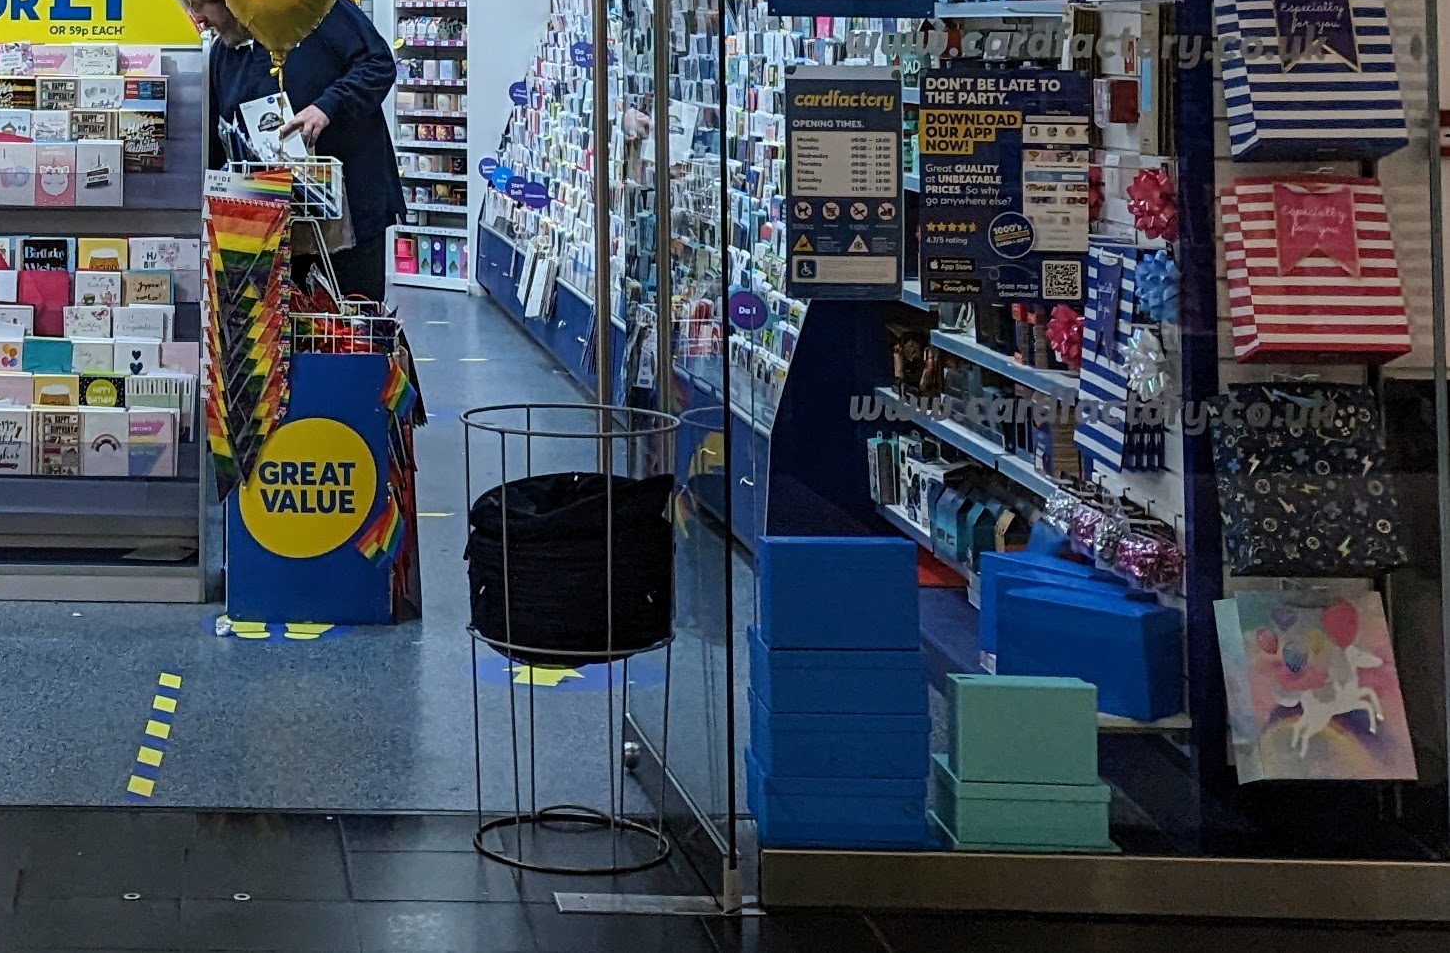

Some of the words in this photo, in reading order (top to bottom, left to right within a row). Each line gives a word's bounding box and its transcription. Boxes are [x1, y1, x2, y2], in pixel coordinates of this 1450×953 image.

[1280, 1, 1345, 18] Especially
[49, 26, 66, 36] OR
[68, 26, 89, 38] 59p
[1290, 17, 1310, 34] for
[1315, 20, 1341, 33] you
[925, 77, 974, 91] DON'T
[977, 78, 996, 91] BE
[999, 78, 1036, 92] LATE
[1038, 79, 1061, 92] TO
[794, 90, 895, 111] cardfactory
[925, 92, 953, 104] THE
[958, 92, 1009, 106] PARTY.
[792, 120, 834, 128] OPENING
[836, 119, 865, 128] TIMES.
[925, 112, 1017, 126] DOWNLOAD
[925, 126, 959, 139] OUR
[962, 127, 993, 140] APP
[925, 139, 969, 152] NOW!
[925, 163, 952, 173] Great
[954, 164, 999, 174] QUALITY
[925, 175, 935, 183] at
[938, 174, 1002, 184] UNBEATABLE
[965, 185, 978, 195] So
[980, 186, 1000, 198] why
[925, 197, 939, 207] go
[940, 196, 987, 206] anywhere
[989, 196, 1012, 205] else?
[926, 236, 944, 244] 4.7/5
[945, 236, 968, 245] rating
[940, 263, 954, 272] App
[955, 263, 973, 271] Store
[942, 283, 965, 293] Google
[967, 284, 980, 293] Play
[258, 460, 356, 486] GREAT
[259, 488, 356, 515] VALUE
